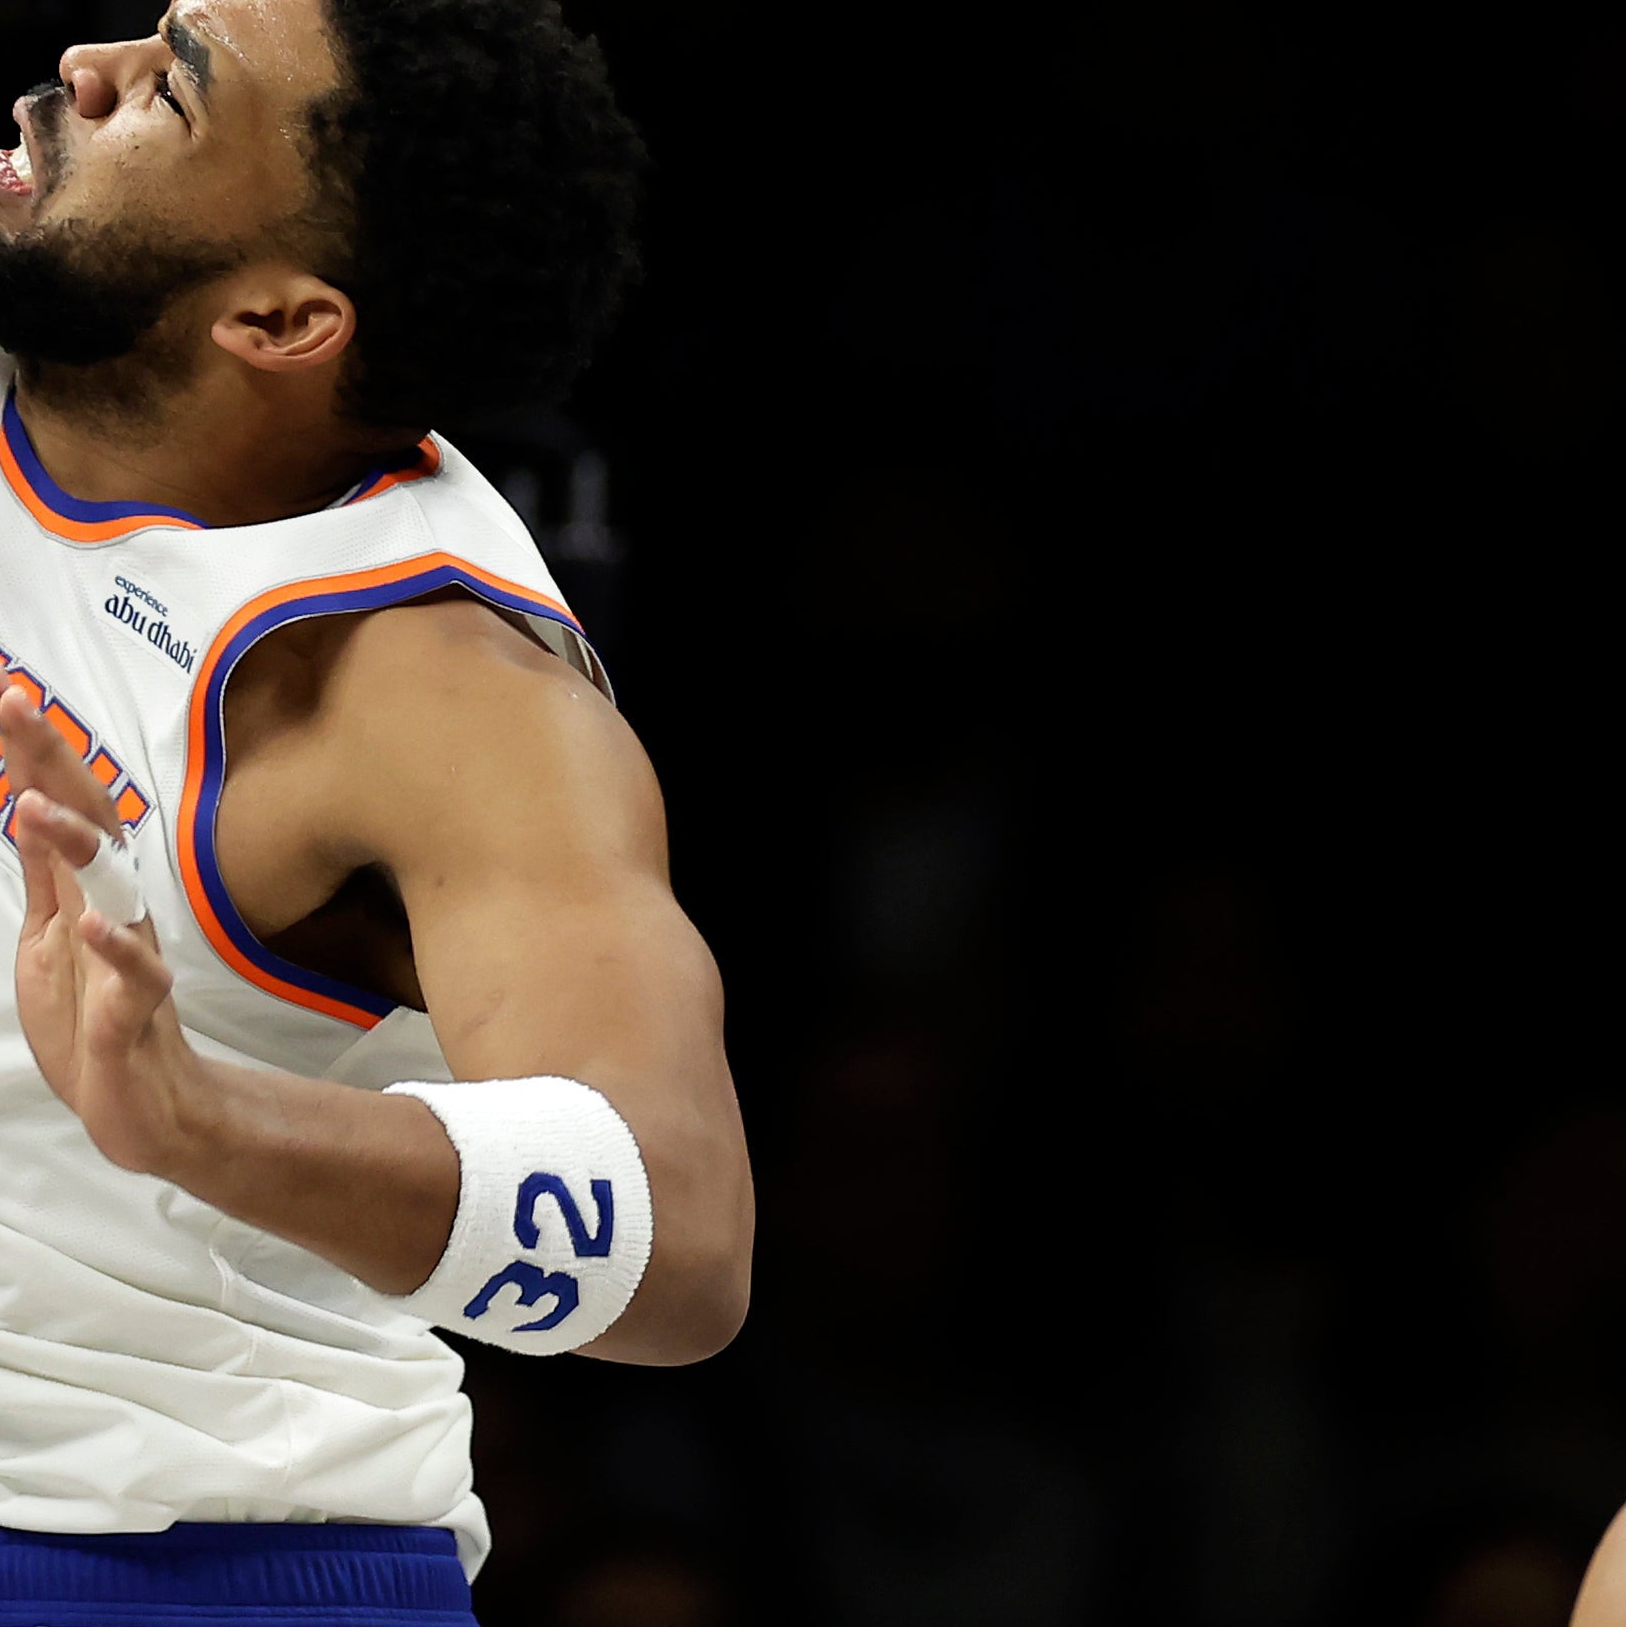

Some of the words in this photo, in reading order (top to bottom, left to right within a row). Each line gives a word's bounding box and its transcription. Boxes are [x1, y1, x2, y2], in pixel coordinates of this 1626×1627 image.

[104, 594, 147, 635] abu
[147, 620, 197, 674] dhabi
[114, 575, 168, 617] experience
[463, 1171, 615, 1332] 32
